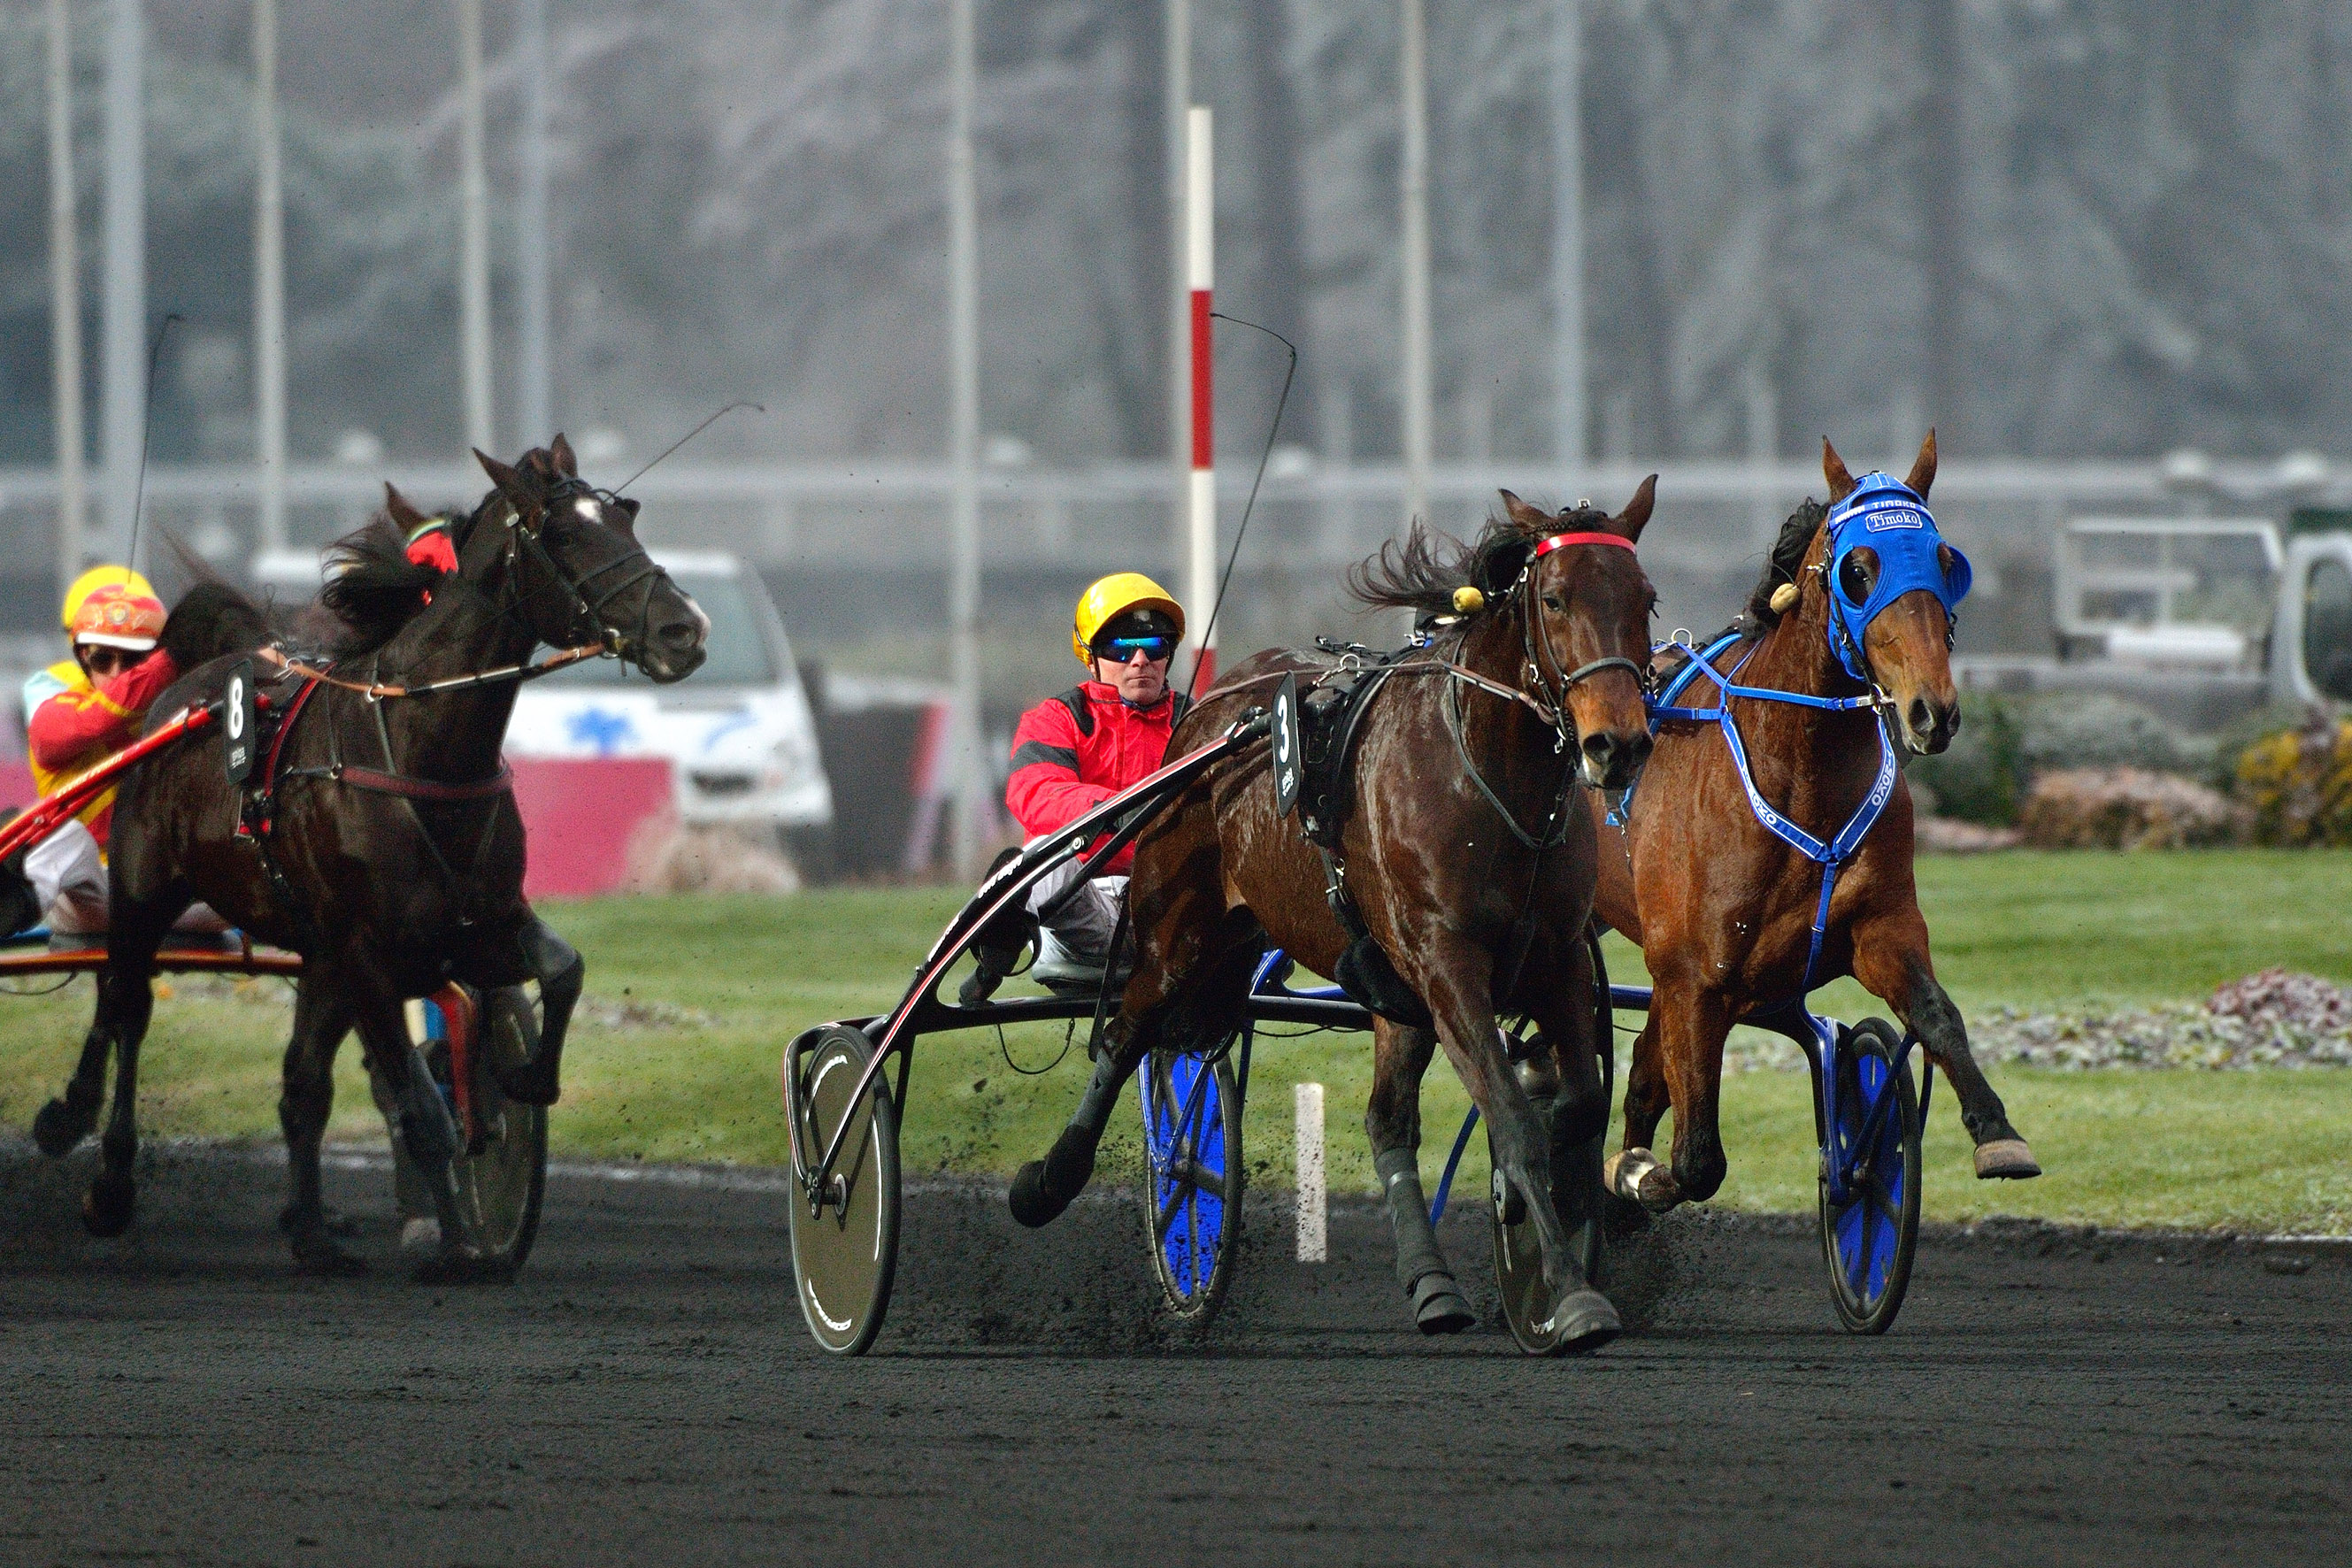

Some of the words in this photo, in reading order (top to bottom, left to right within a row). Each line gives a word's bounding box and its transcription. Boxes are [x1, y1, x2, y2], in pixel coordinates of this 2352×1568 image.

[1870, 511, 1918, 527] Timoko
[1872, 500, 1916, 509] TIMOKO
[227, 676, 244, 741] 8
[1277, 694, 1290, 764] 3
